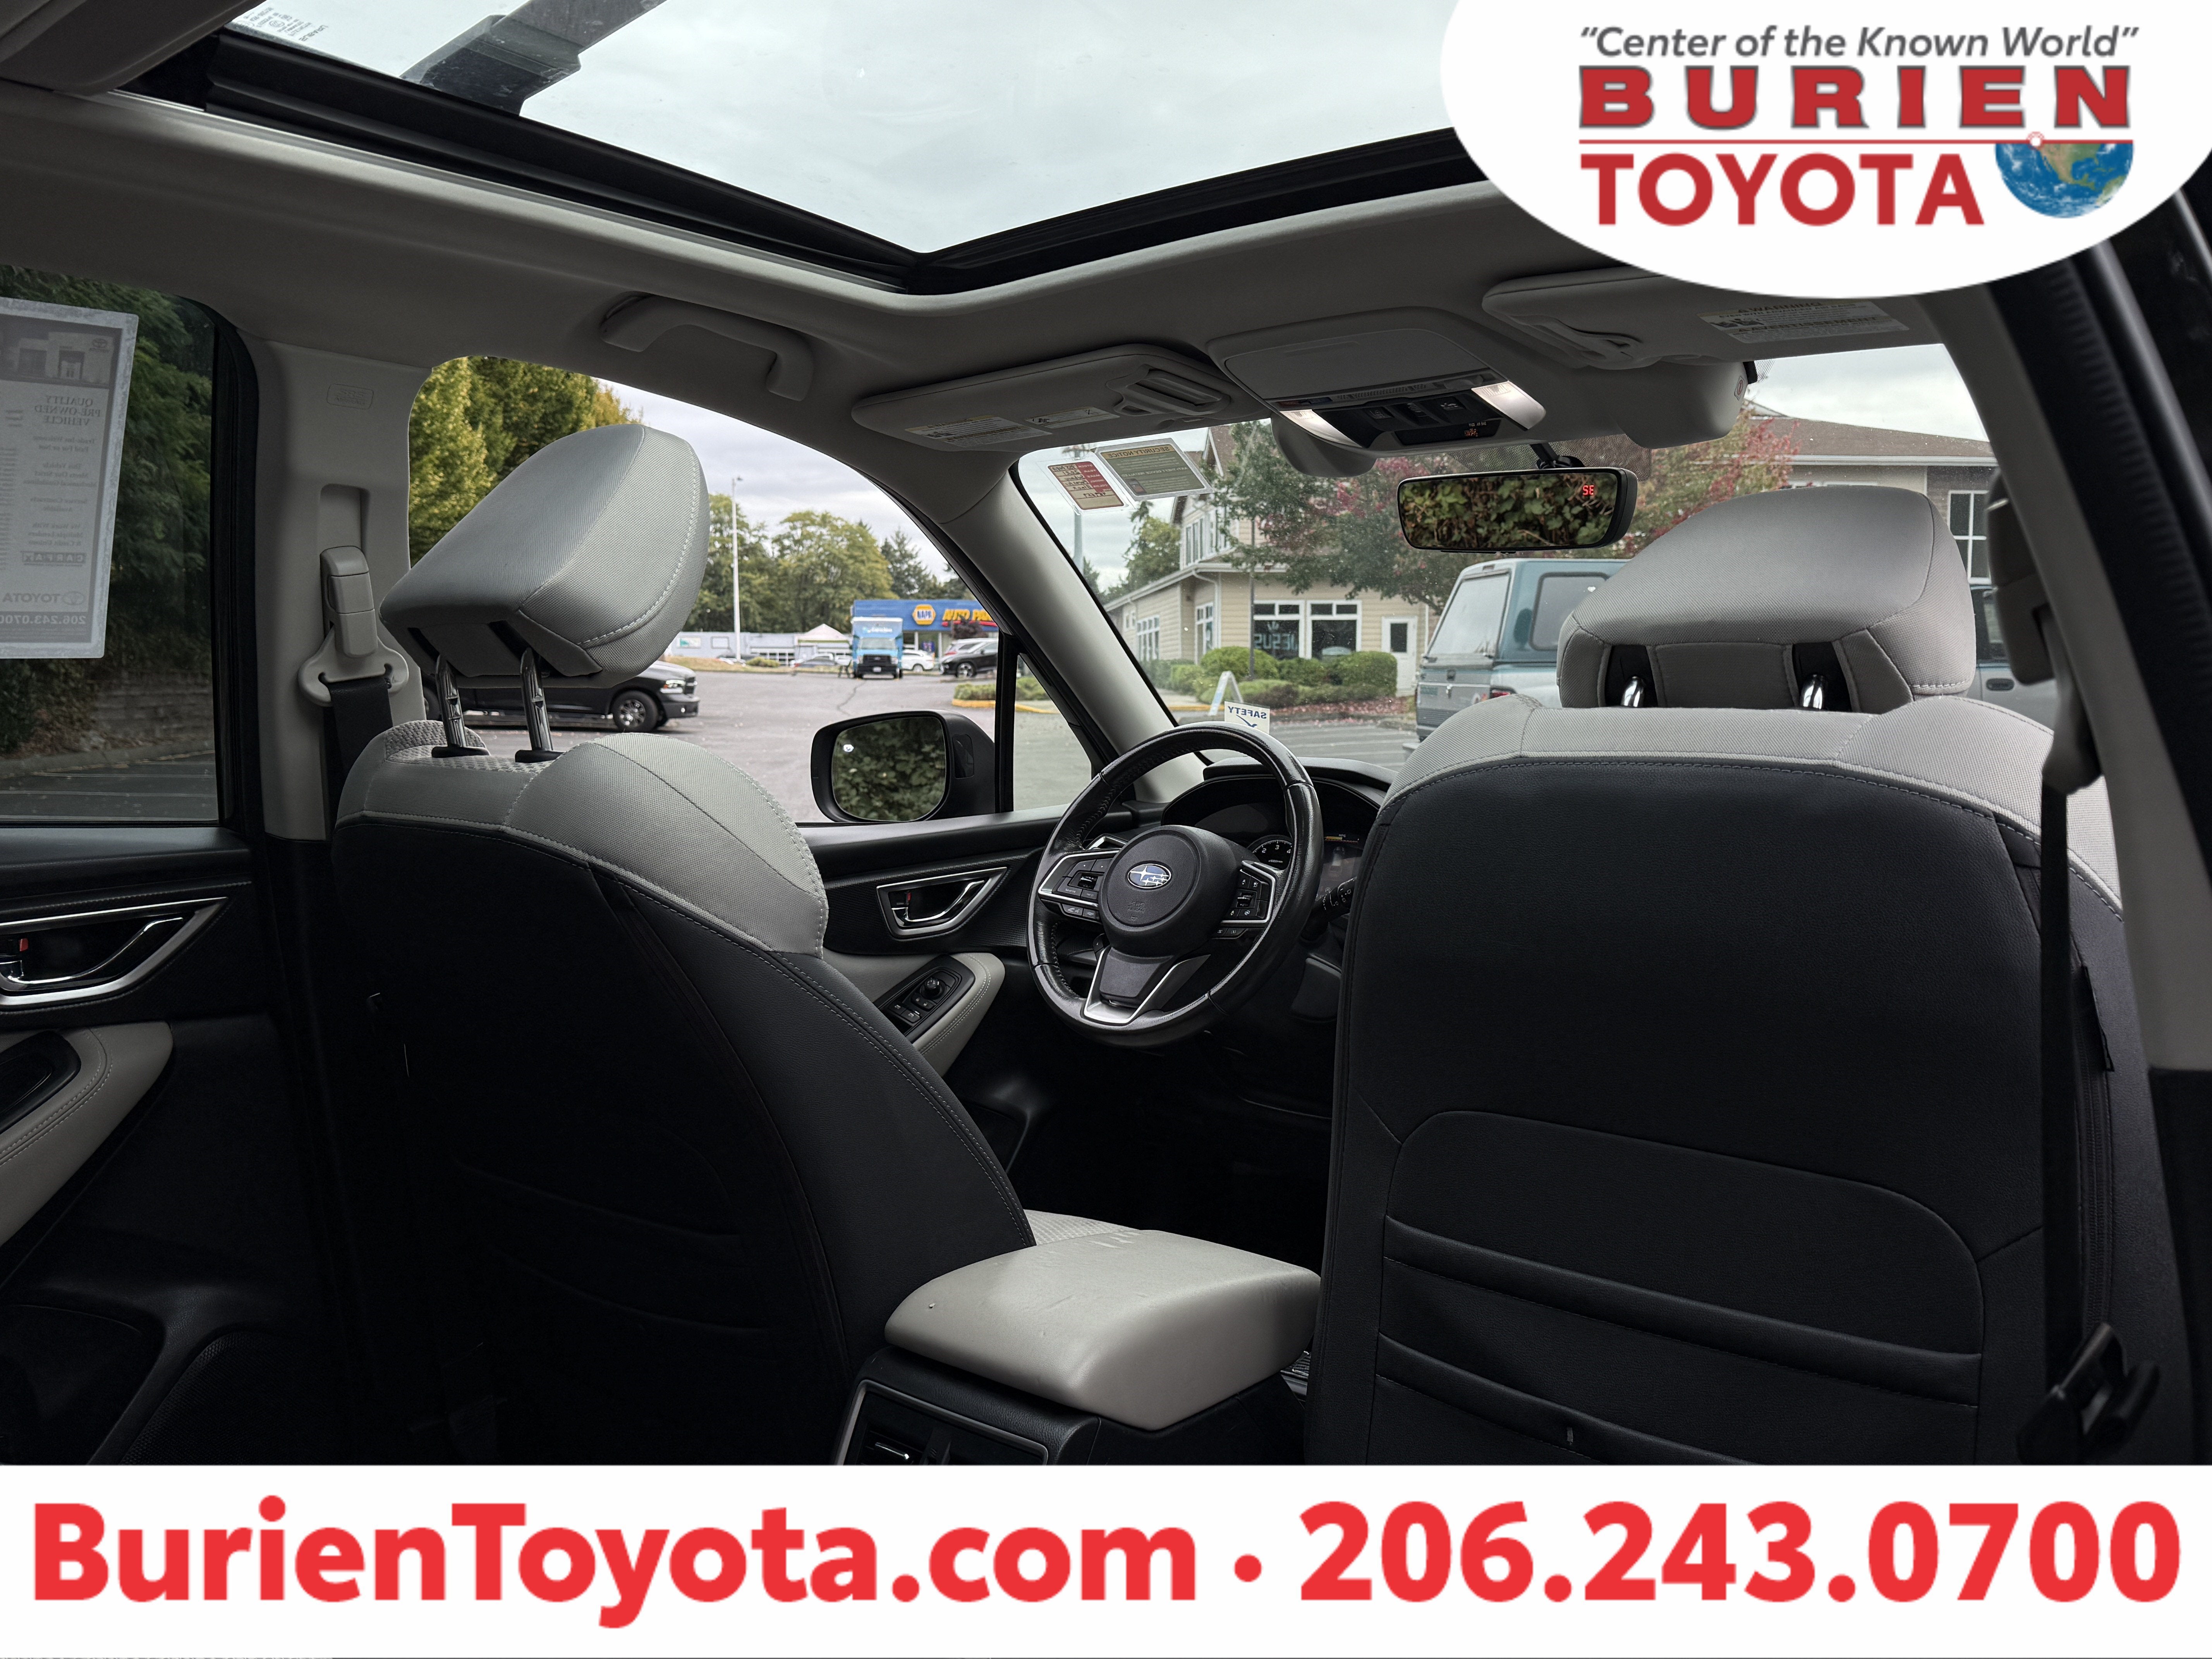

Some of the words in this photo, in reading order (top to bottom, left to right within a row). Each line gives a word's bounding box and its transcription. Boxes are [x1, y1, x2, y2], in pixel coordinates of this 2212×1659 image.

[1582, 485, 1594, 495] SE
[917, 610, 932, 619] NAPA
[942, 609, 970, 621] AUTO
